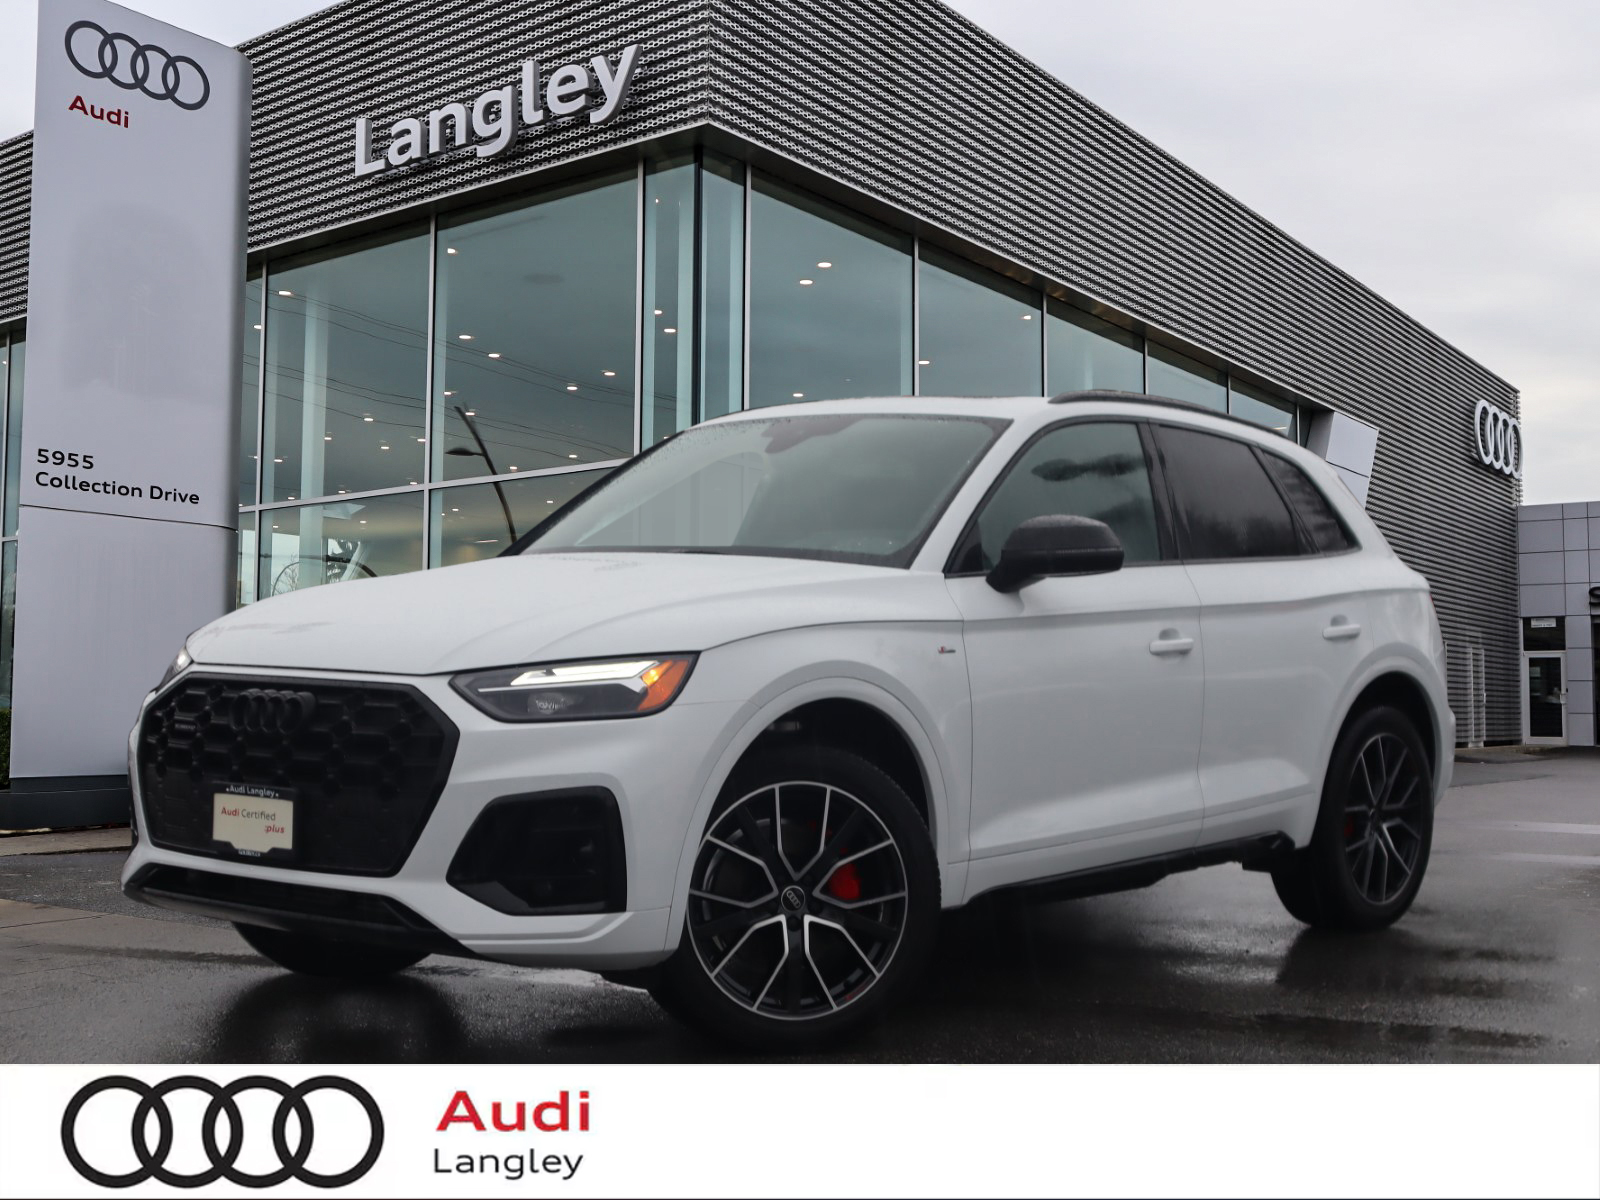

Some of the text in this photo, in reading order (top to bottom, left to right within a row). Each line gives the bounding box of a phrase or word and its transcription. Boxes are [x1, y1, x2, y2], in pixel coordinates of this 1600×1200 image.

[68, 95, 129, 129] Audi
[355, 44, 643, 177] Langley
[37, 448, 94, 470] 5955
[35, 471, 200, 505] Collection Drive
[229, 784, 275, 798] Audi Langley
[221, 806, 276, 821] Audi Certified
